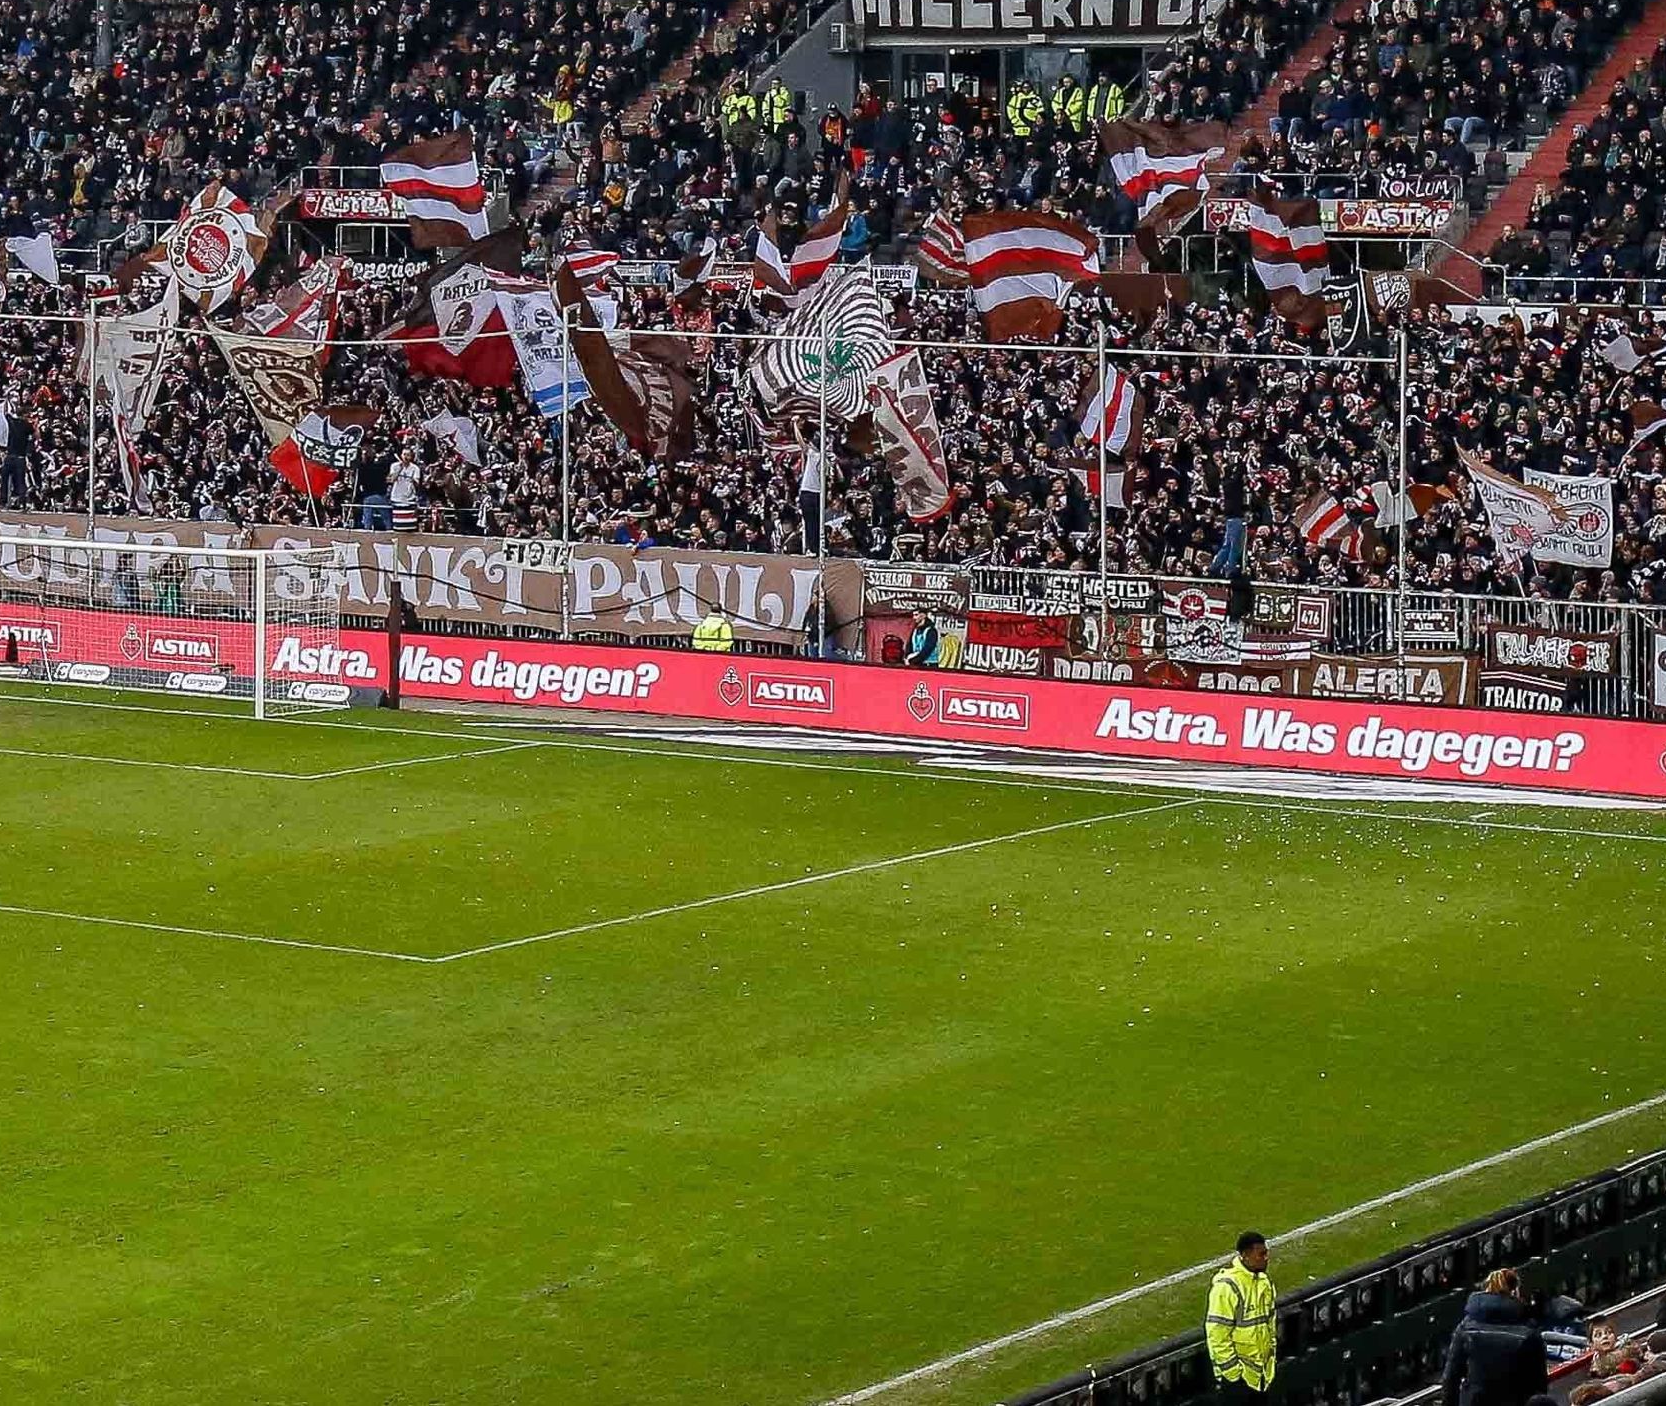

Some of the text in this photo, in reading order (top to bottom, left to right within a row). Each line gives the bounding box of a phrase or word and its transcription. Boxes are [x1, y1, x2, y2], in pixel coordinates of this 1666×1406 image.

[572, 555, 821, 632] PAULI
[1083, 578, 1150, 597] WASTED
[151, 637, 213, 659] ASTRA
[272, 636, 661, 703] Astra. Was dagegen?
[1312, 663, 1443, 695] ALERTA
[755, 680, 827, 704] ASTRA
[1484, 686, 1563, 711] TRAKTOR
[946, 697, 1023, 722] ASTRA
[1095, 697, 1585, 776] Astra. Was dagegen?
